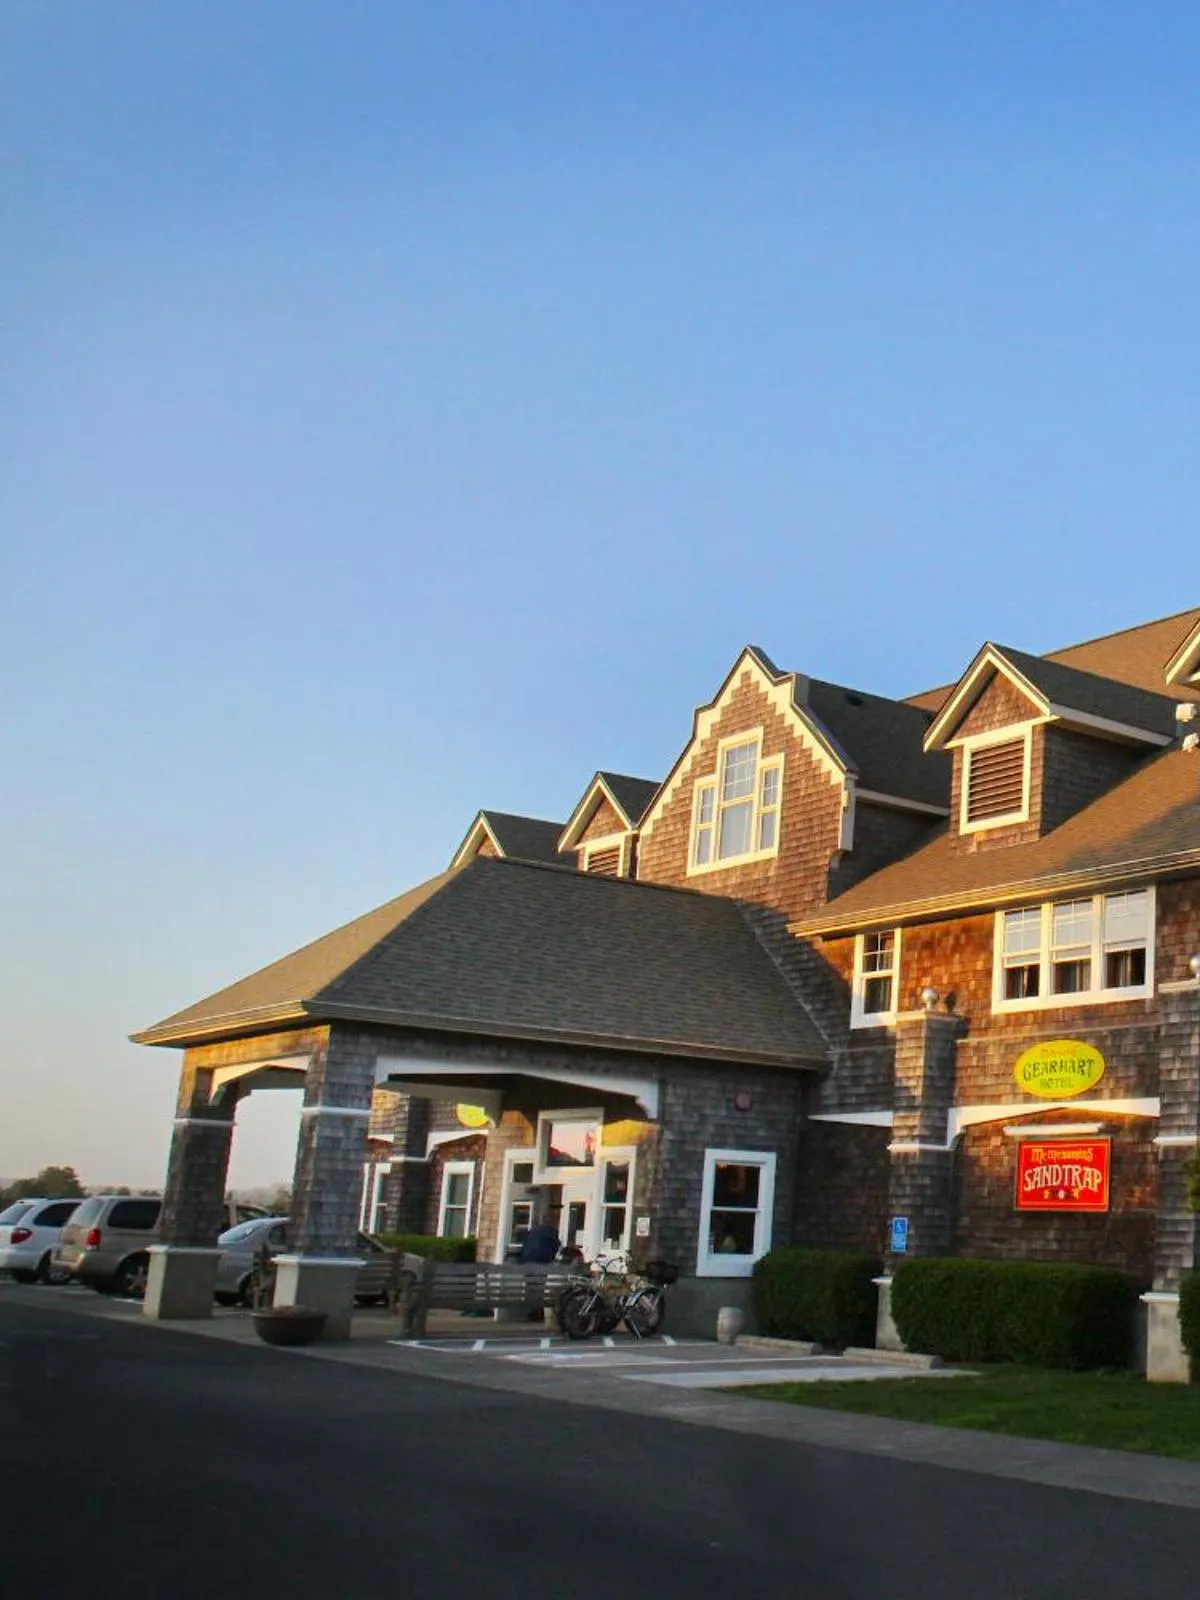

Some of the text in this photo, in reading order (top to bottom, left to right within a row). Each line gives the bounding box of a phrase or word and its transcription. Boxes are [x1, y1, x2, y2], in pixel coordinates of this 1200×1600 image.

[1023, 1058, 1095, 1082] GEARHART
[1040, 1077, 1075, 1089] HOTEL
[1023, 1164, 1102, 1193] SANDTRAP
